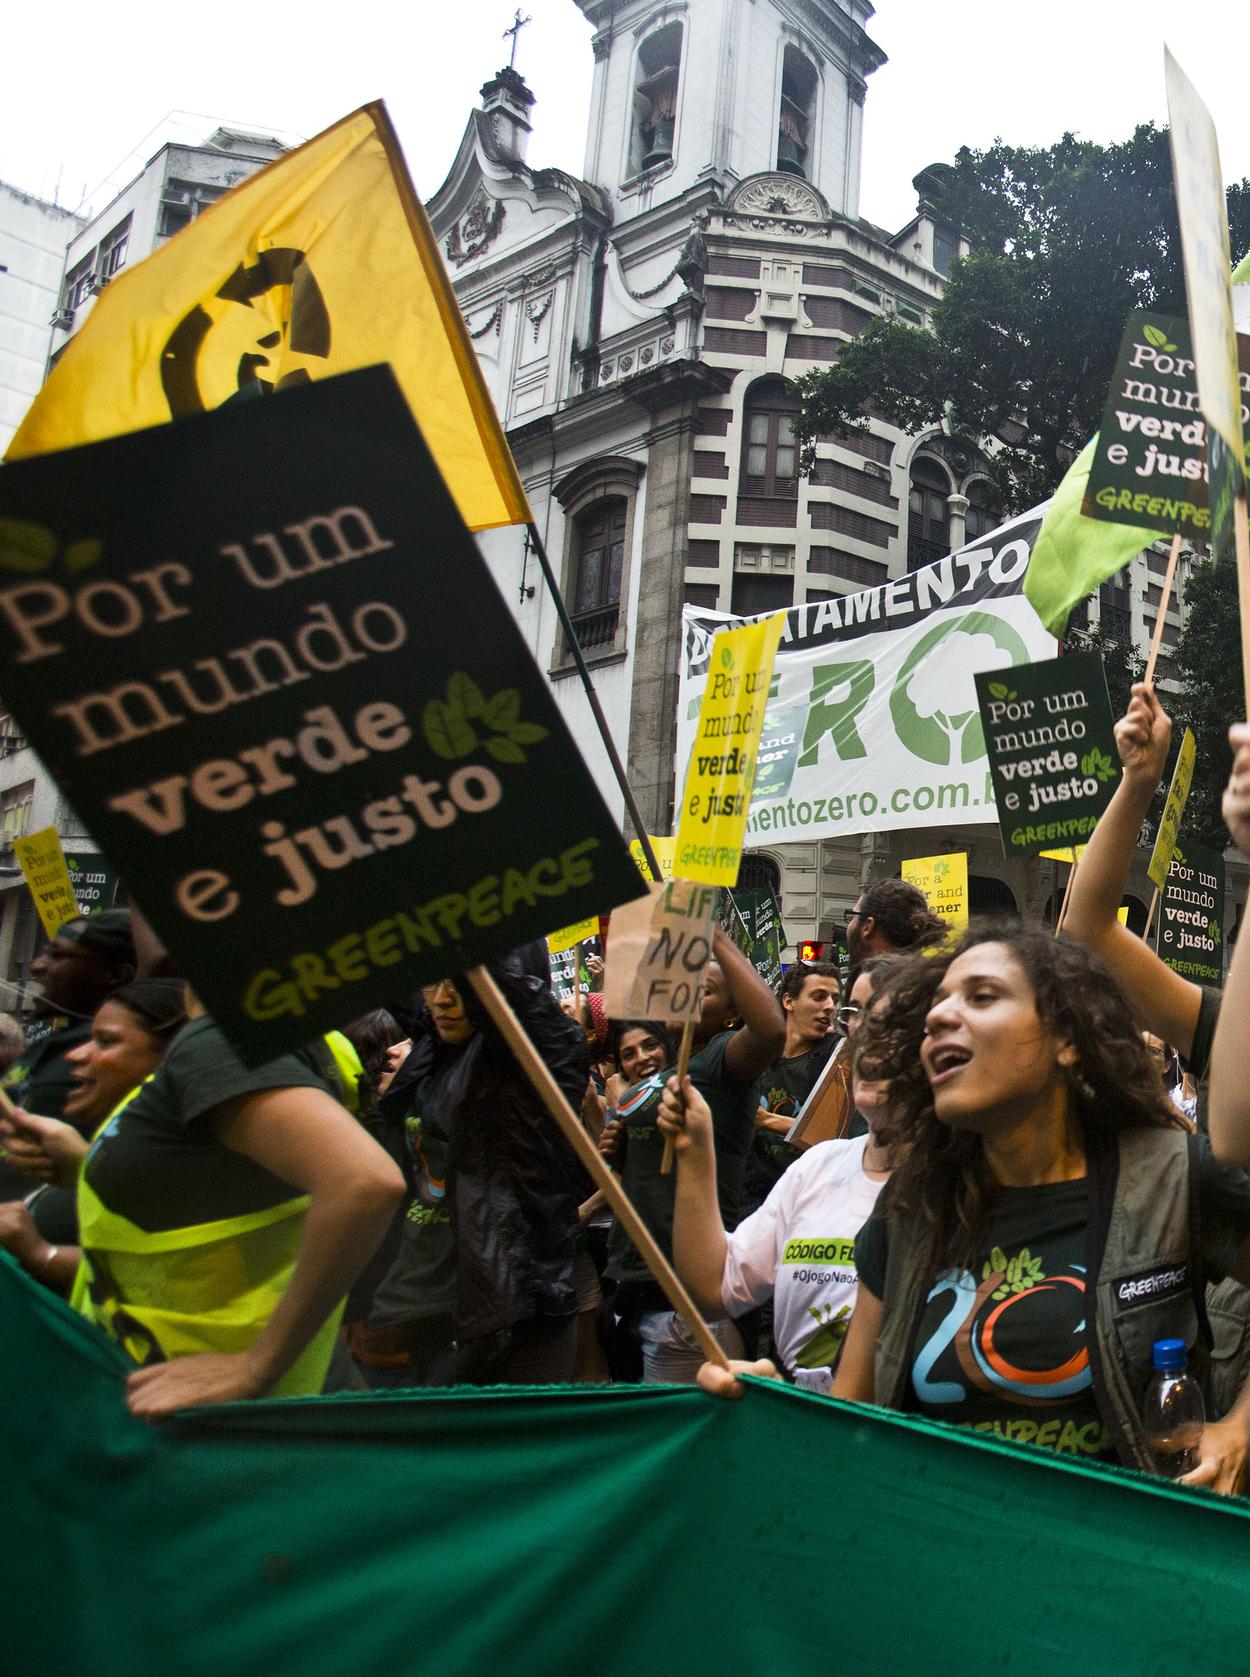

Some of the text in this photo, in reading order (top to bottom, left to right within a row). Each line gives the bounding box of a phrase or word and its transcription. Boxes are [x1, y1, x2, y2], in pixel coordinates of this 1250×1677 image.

[1128, 343, 1195, 377] Por
[1115, 410, 1207, 447] verd
[1107, 443, 1208, 484] e jus
[1096, 486, 1211, 528] GREENPE
[0, 505, 394, 664] Por um
[53, 601, 408, 757] mundo
[702, 706, 756, 738] mund
[988, 688, 1088, 725] Por um
[994, 718, 1086, 754] mundo
[109, 700, 413, 837] verde
[999, 749, 1079, 781] verde
[689, 795, 700, 816] e
[1005, 776, 1098, 812] e justo
[176, 763, 502, 922] e justo
[1010, 816, 1100, 847] GREENPEA
[87, 873, 106, 884] um
[934, 874, 942, 884] a
[1168, 860, 1217, 889] Por um
[74, 887, 100, 899] undo
[937, 886, 962, 898] and
[1166, 884, 1214, 908] mundo
[242, 837, 598, 1022] GREENPEACE
[1165, 907, 1208, 928] verde
[1164, 930, 1214, 951] e justo
[786, 1240, 836, 1260] CÓDIGO
